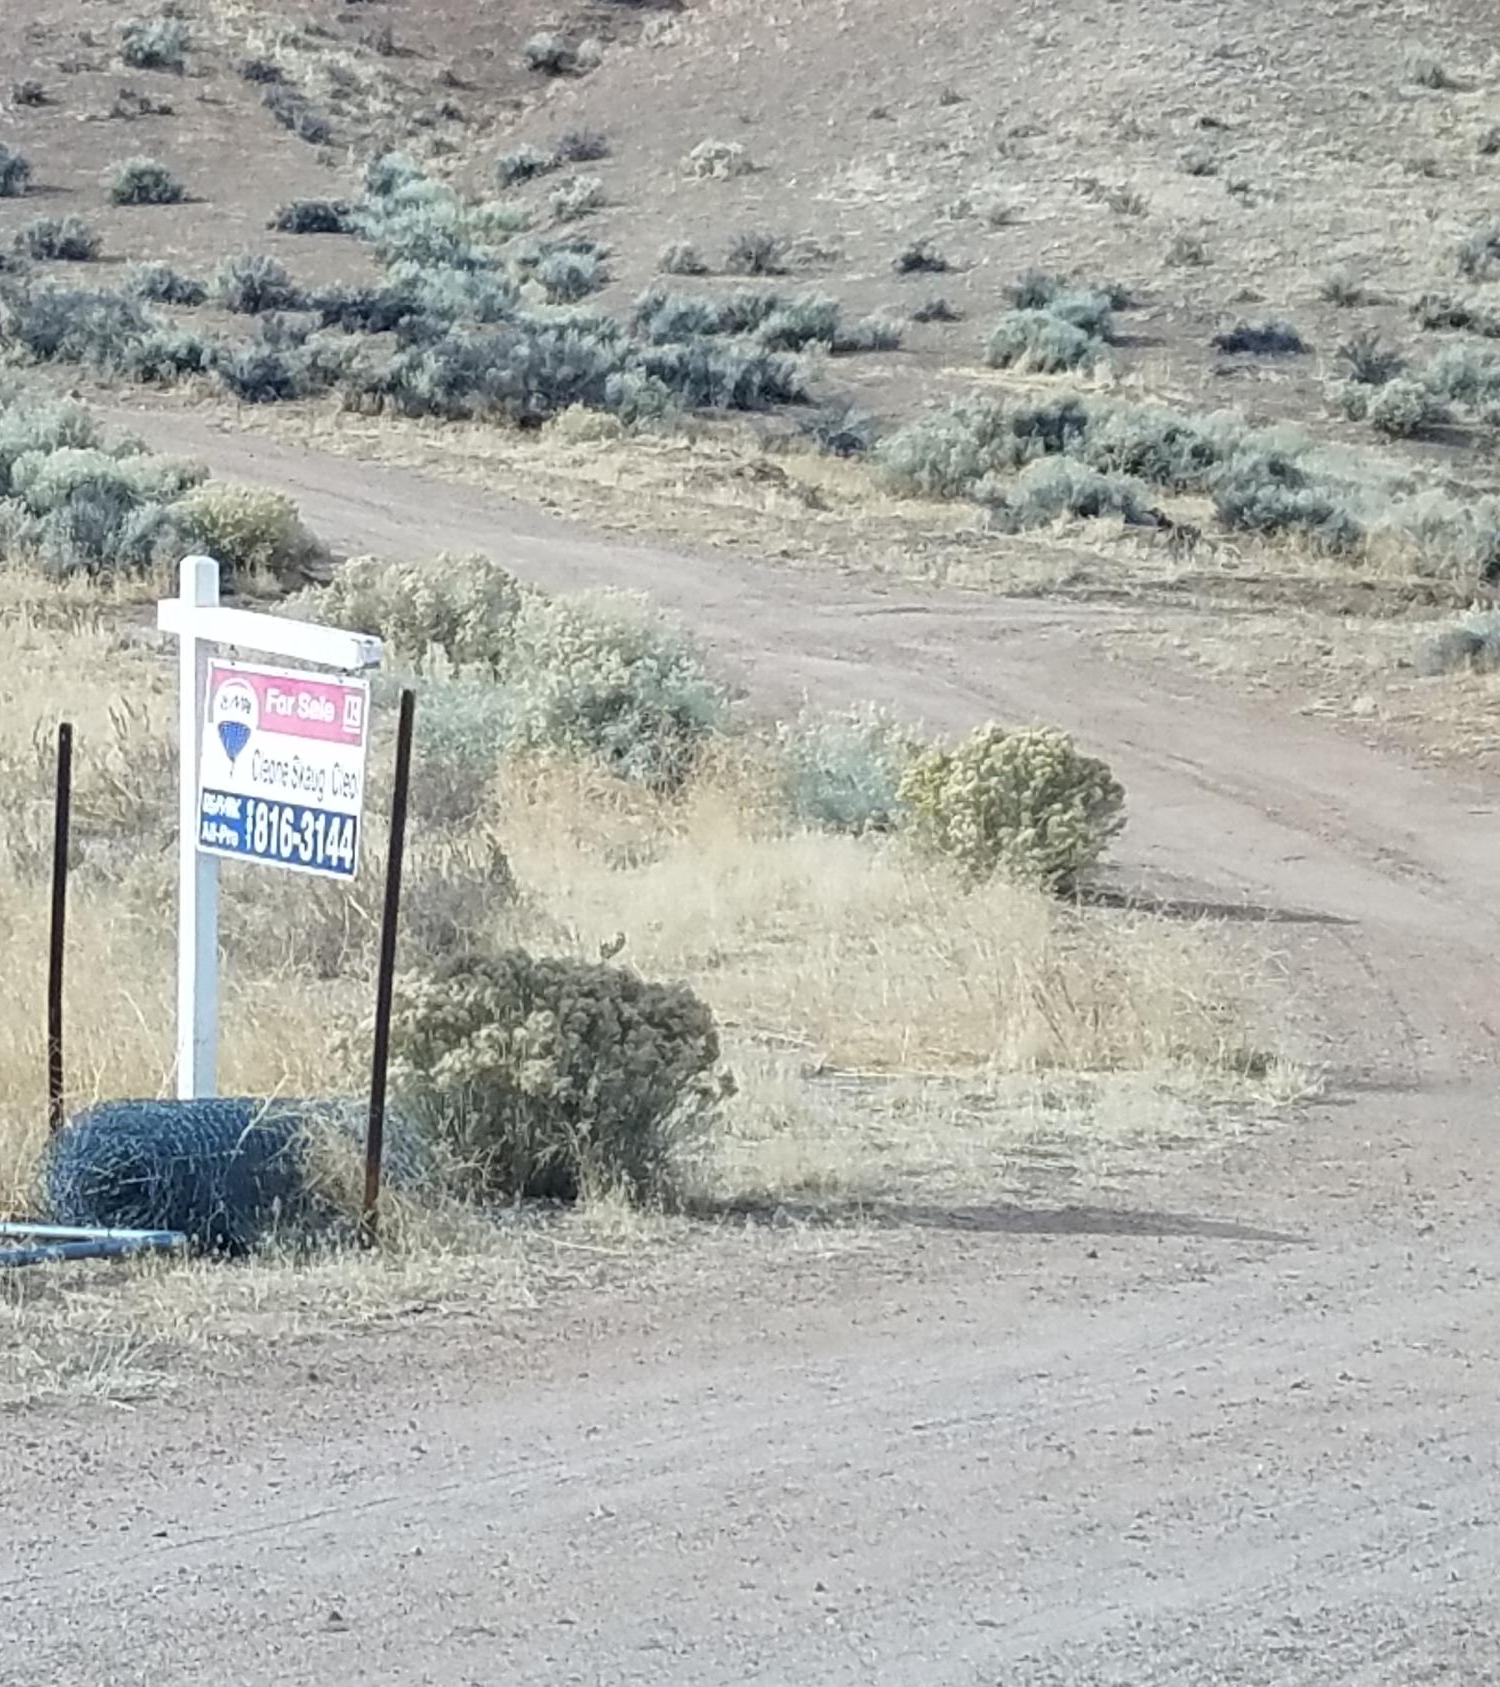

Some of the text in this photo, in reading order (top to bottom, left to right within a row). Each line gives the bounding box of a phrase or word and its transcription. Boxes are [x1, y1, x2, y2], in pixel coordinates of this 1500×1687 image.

[265, 687, 295, 716] For
[297, 692, 335, 722] Sale
[254, 802, 354, 869] 816-3144
